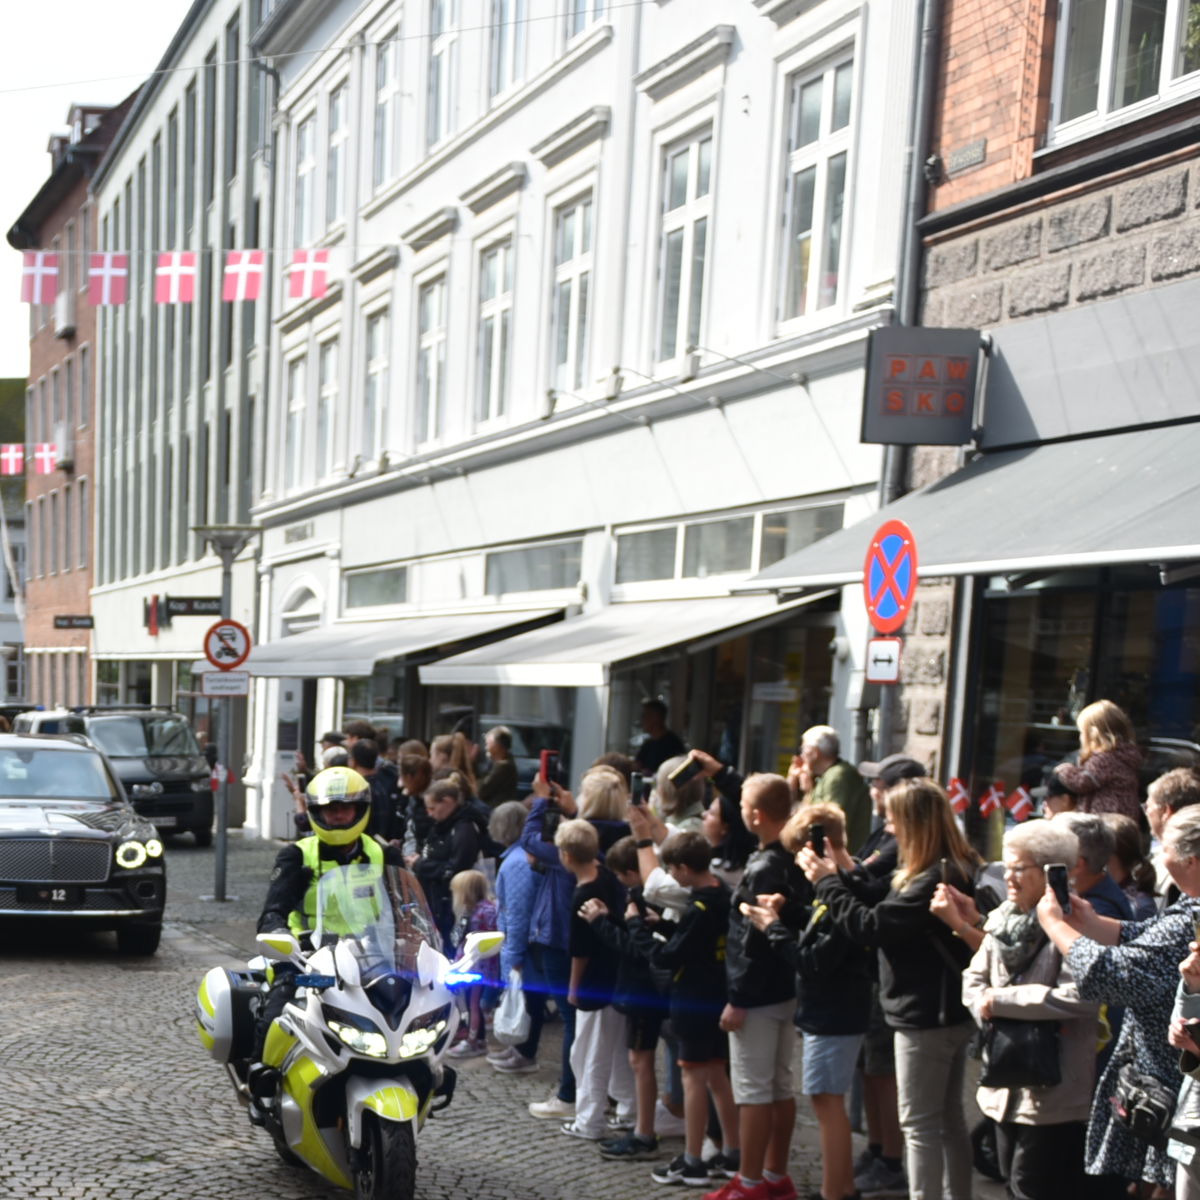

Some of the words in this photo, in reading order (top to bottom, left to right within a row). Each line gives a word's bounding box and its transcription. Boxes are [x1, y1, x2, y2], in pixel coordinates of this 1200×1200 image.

[890, 359, 969, 379] PAW
[886, 391, 964, 412] SKO
[52, 888, 66, 901] 12
